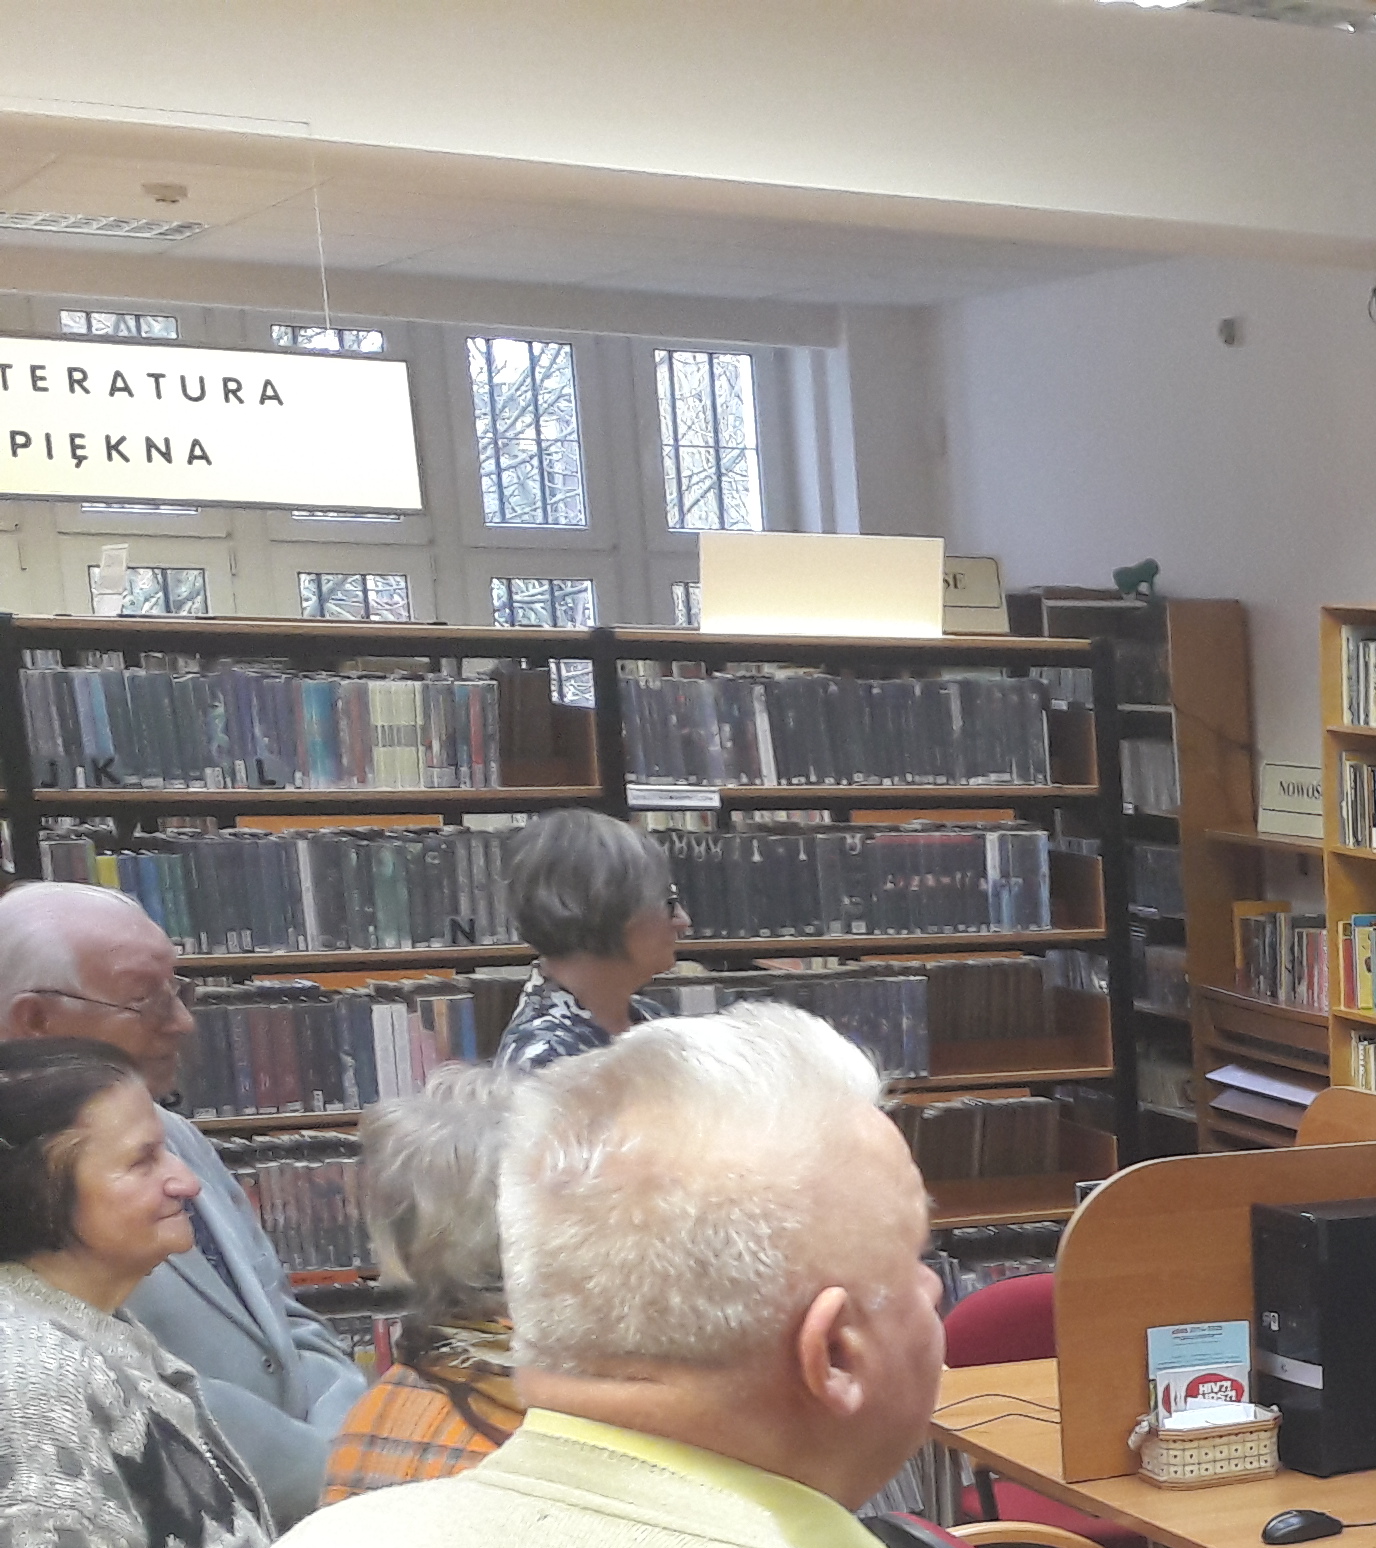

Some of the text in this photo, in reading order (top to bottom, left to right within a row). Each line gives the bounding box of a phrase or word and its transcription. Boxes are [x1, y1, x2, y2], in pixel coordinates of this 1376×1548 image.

[0, 363, 284, 406] TERATURA
[9, 430, 213, 468] PIĘKNA
[92, 757, 120, 785] K
[254, 758, 277, 785] L
[450, 916, 477, 944] N
